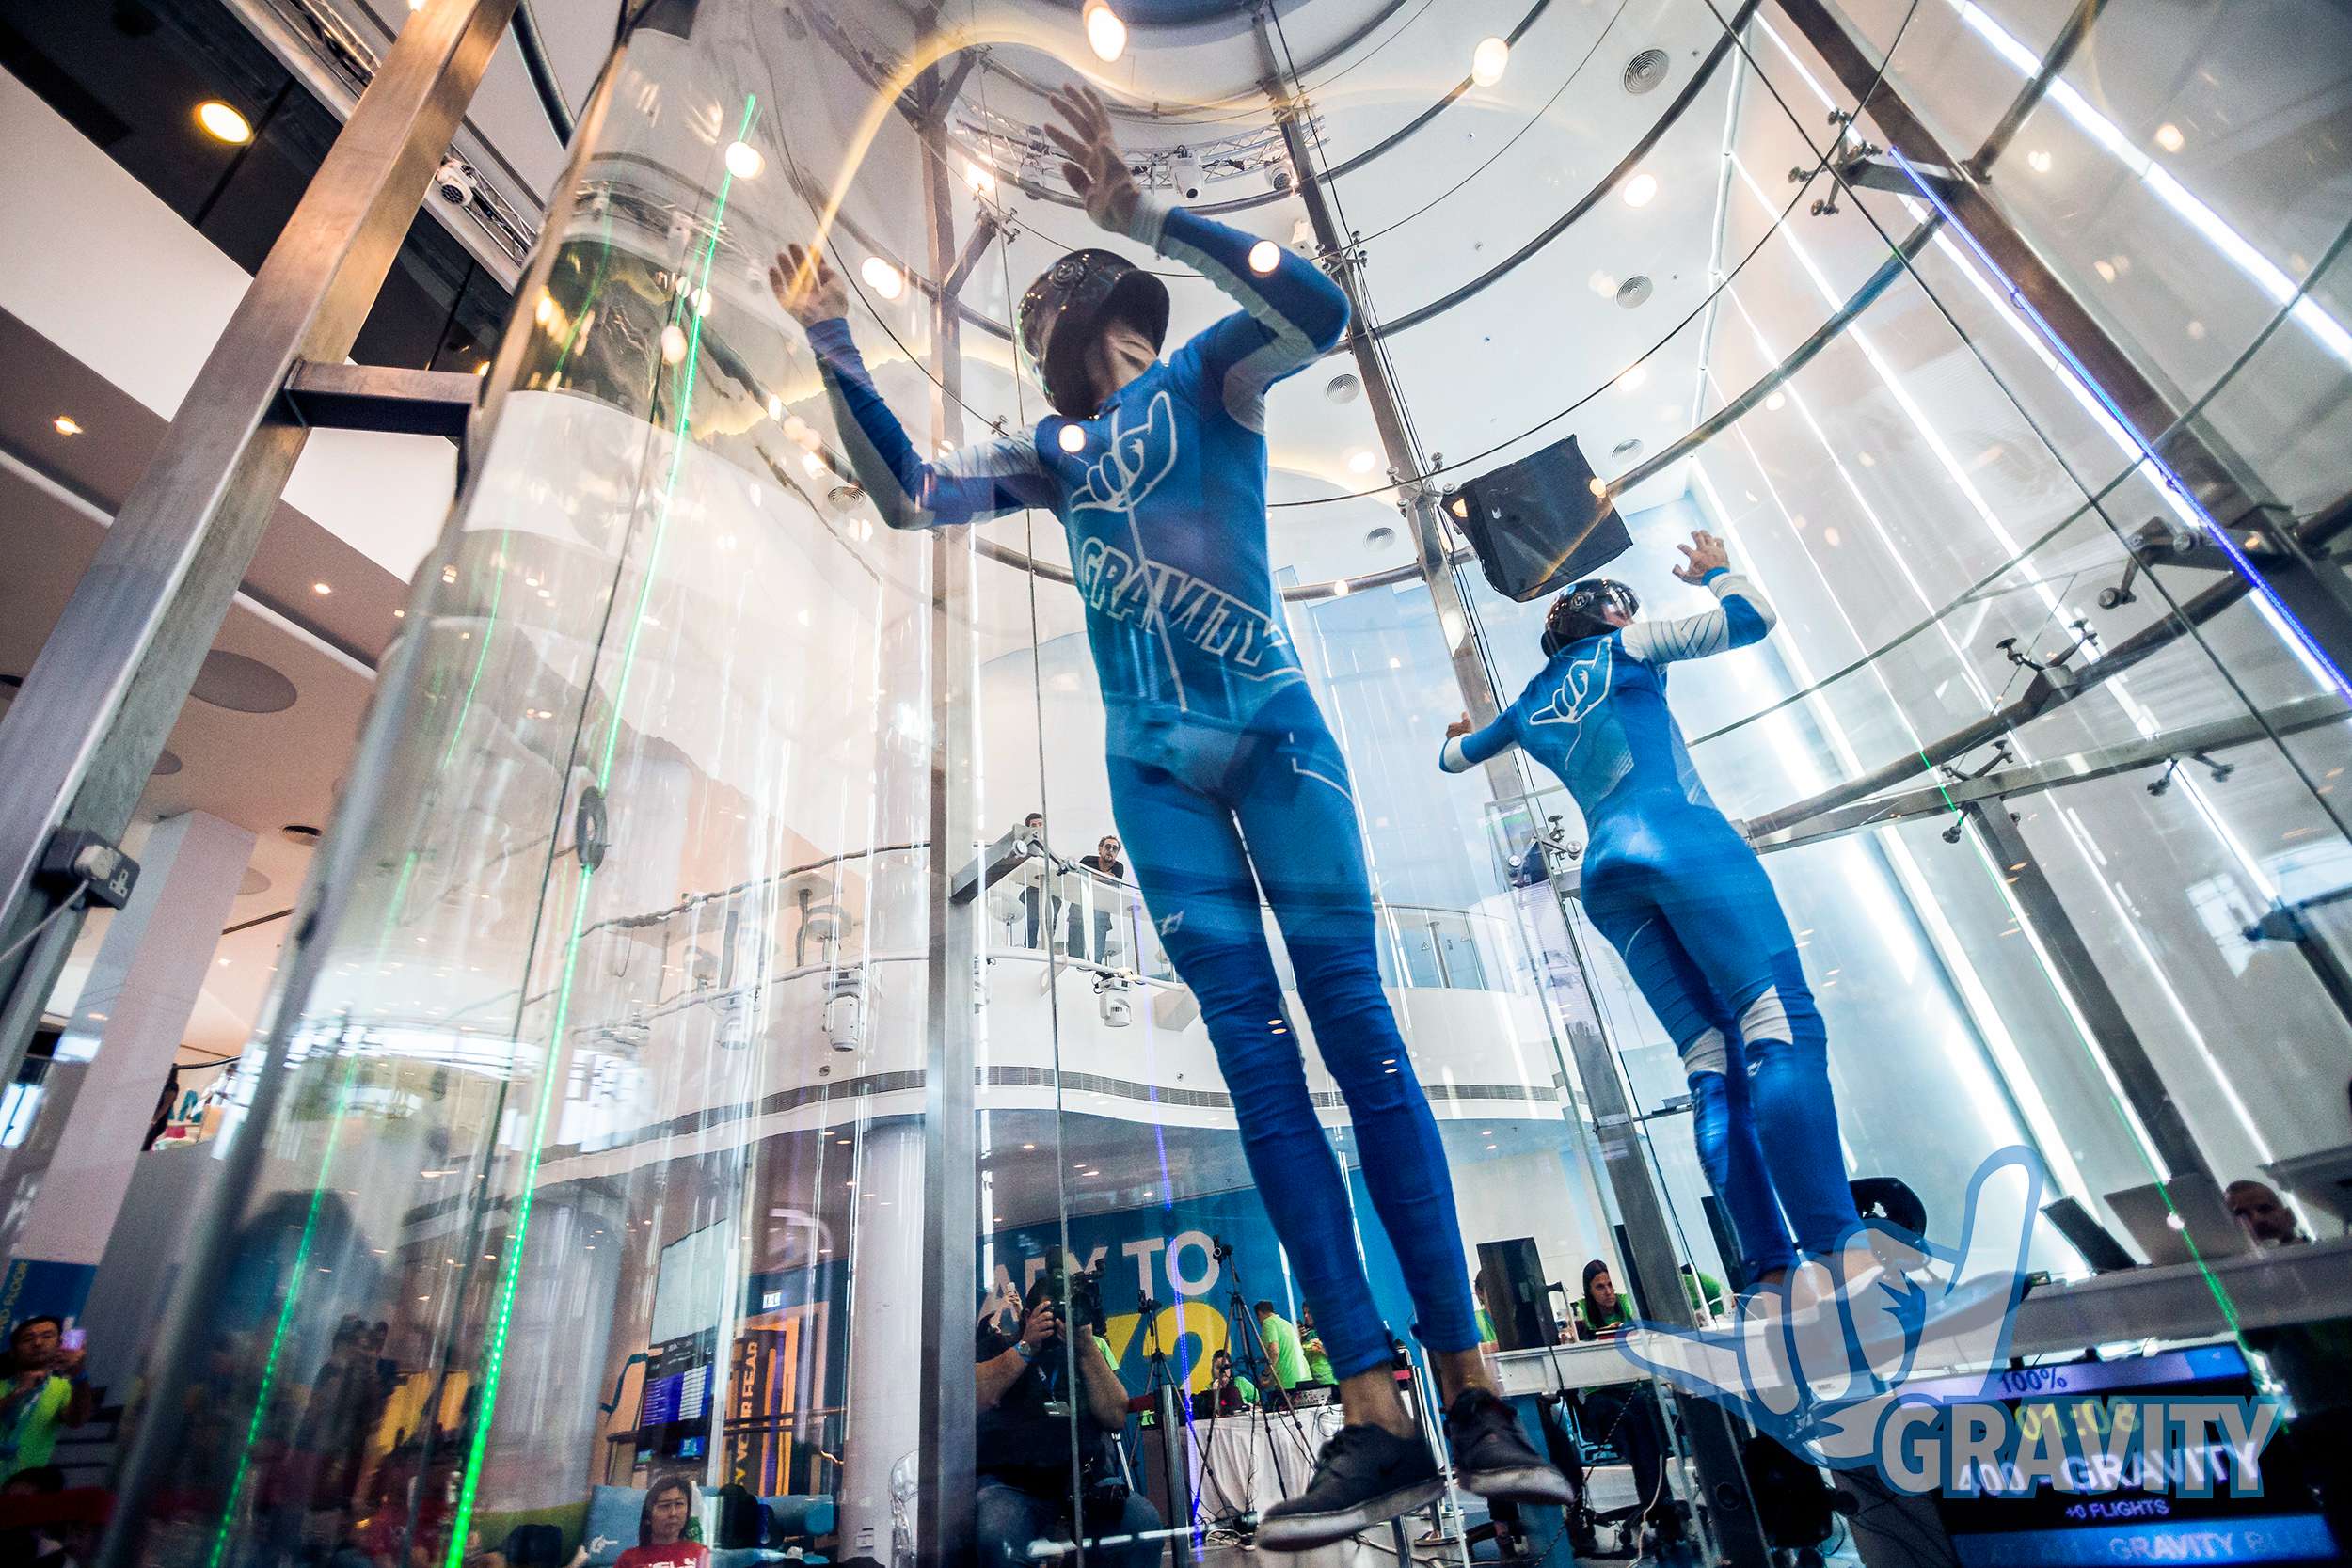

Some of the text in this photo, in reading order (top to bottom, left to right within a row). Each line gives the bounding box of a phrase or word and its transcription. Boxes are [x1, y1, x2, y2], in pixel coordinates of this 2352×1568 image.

[1082, 536, 1288, 667] GRAVITY
[1122, 1230, 1220, 1302] TO
[2002, 1367, 2068, 1393] 100%
[1958, 1462, 2026, 1497] 400
[2061, 1442, 2259, 1491] GRAVITY
[2089, 1499, 2170, 1518] FLIGHTS
[2108, 1532, 2233, 1560] GRAVITY
